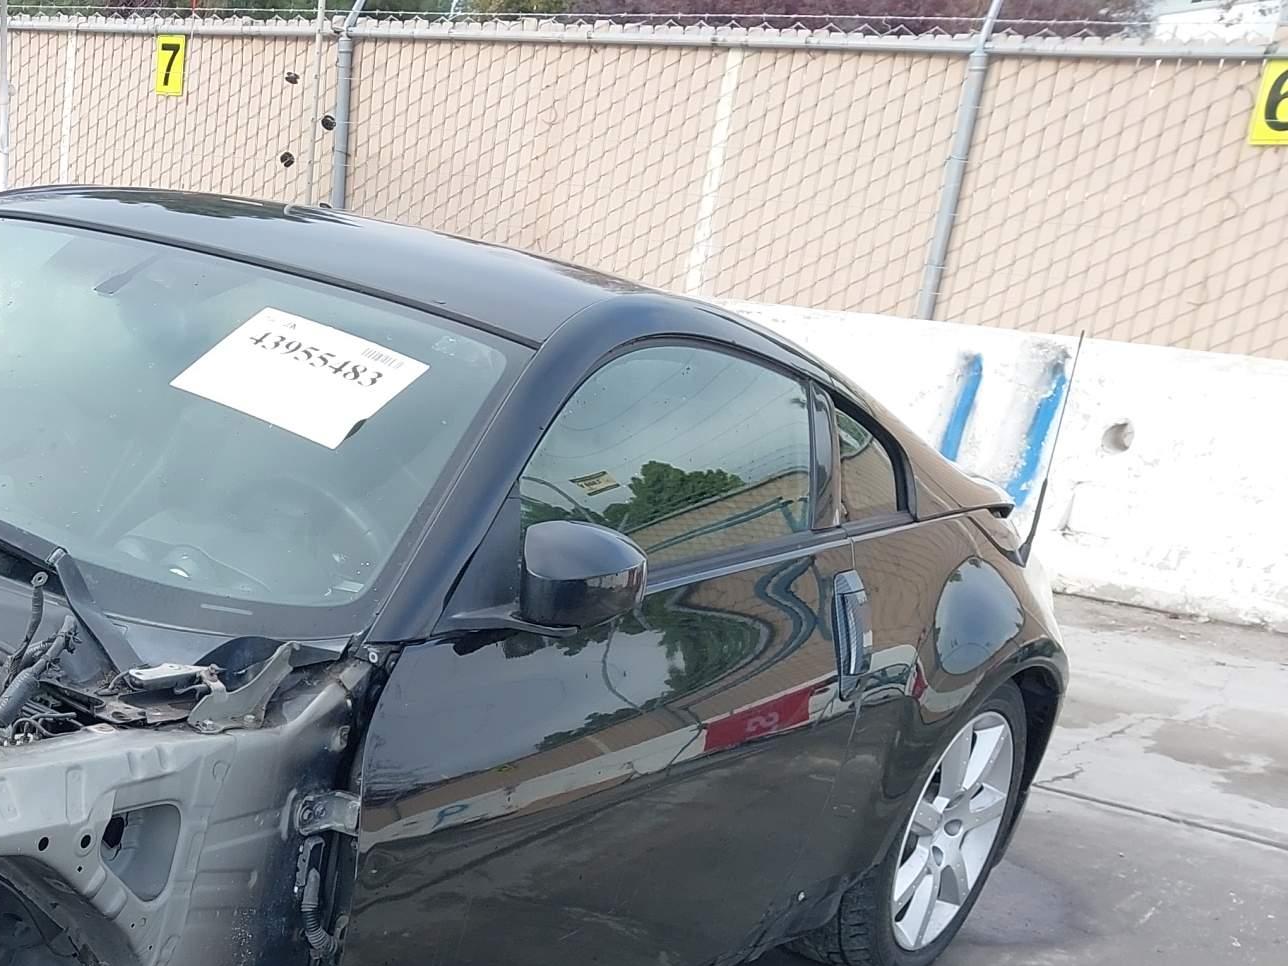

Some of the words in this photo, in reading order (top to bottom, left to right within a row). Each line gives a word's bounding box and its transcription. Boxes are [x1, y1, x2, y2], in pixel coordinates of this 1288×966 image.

[161, 43, 181, 87] 7
[1264, 69, 1288, 132] 6
[249, 331, 384, 387] 43955483
